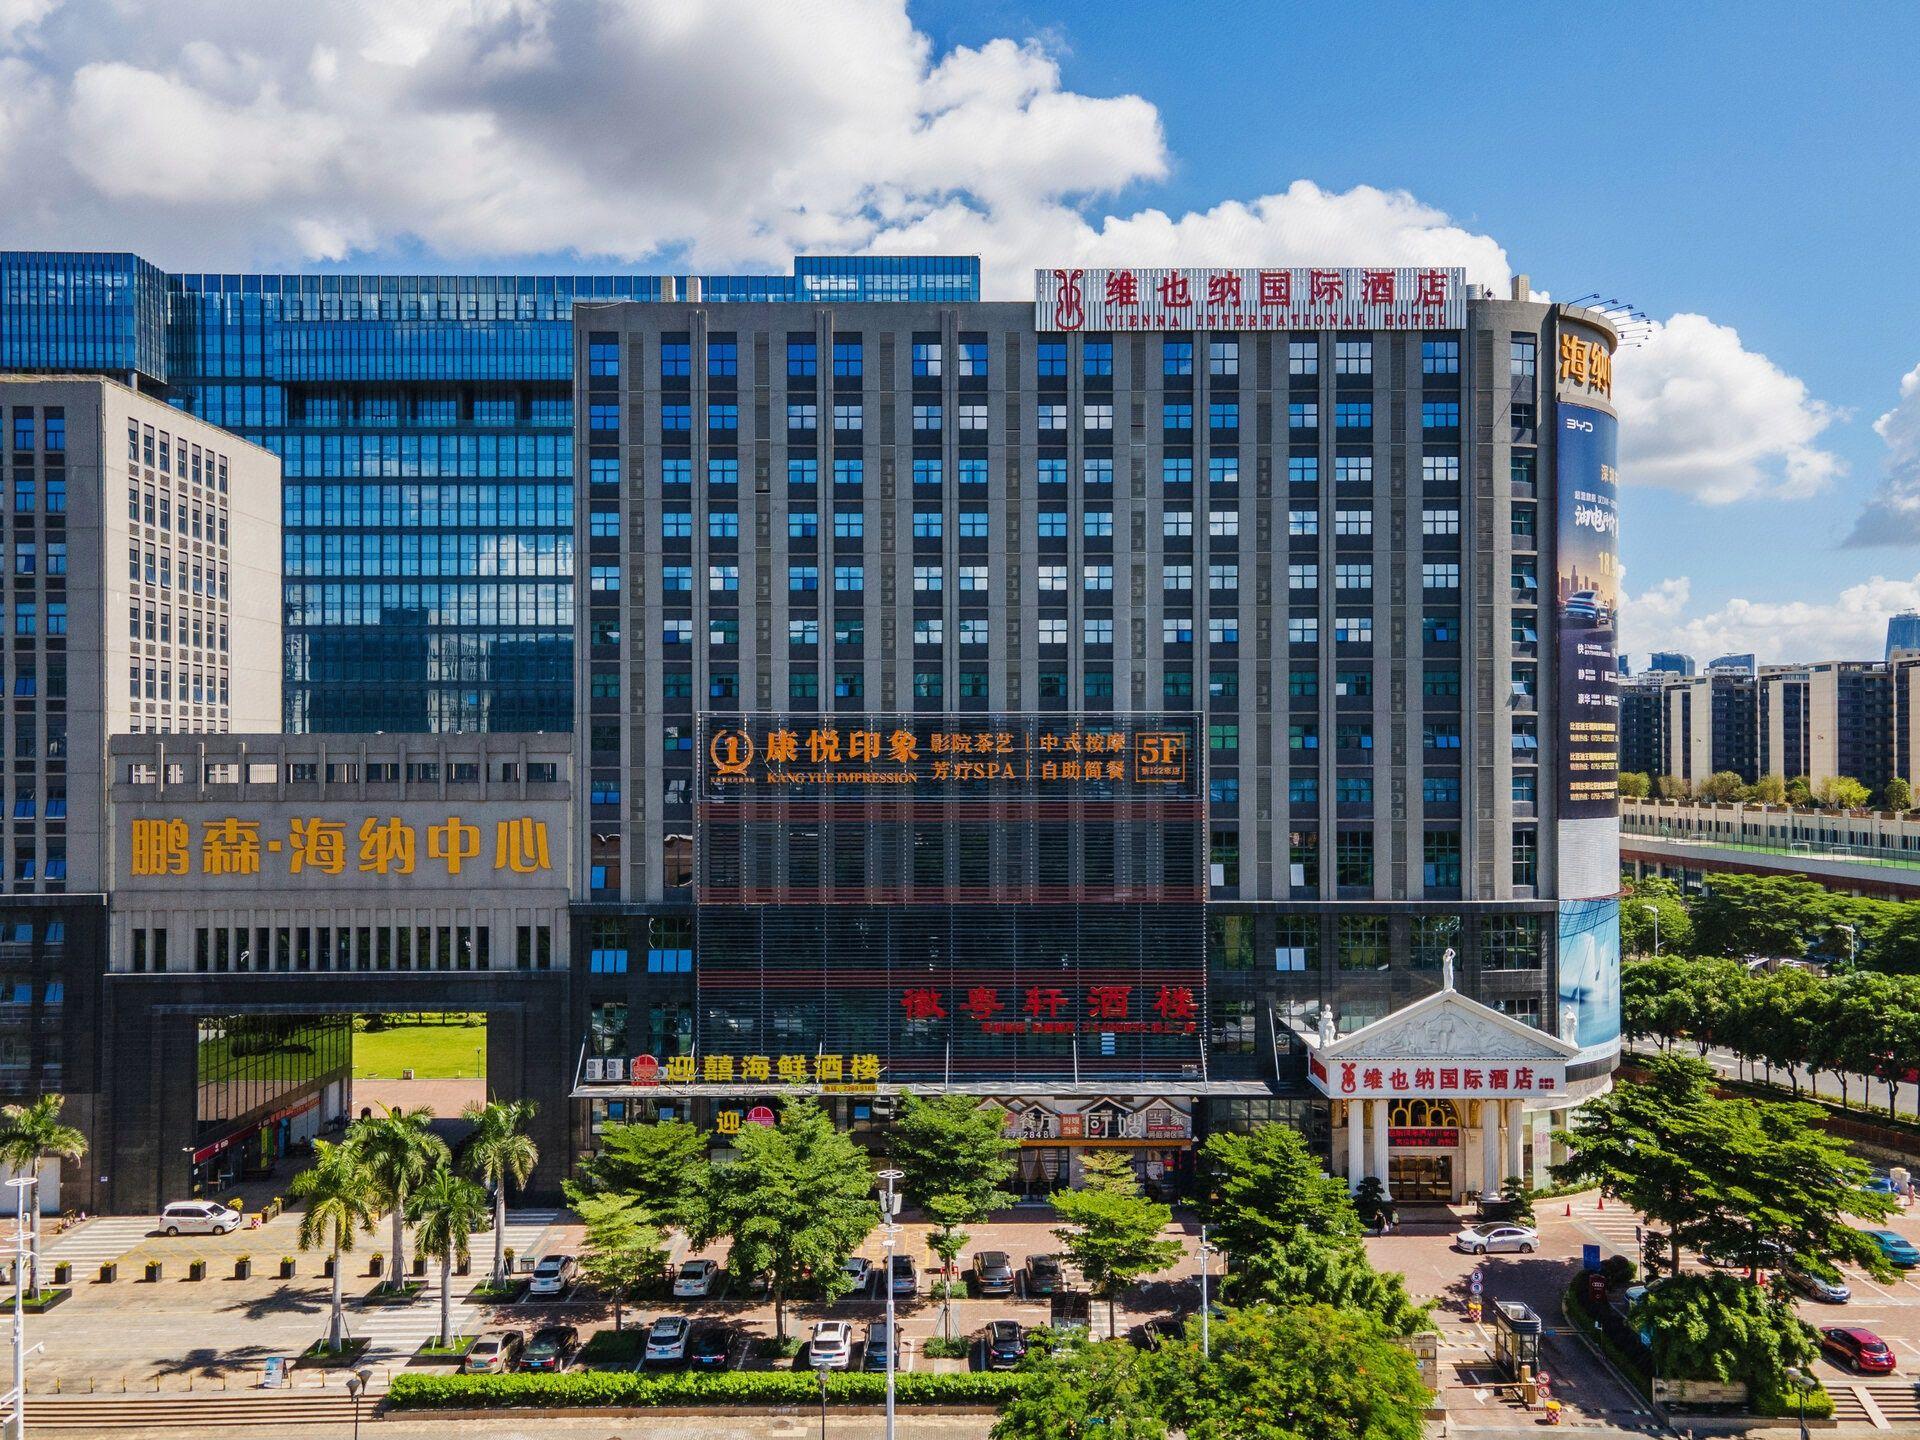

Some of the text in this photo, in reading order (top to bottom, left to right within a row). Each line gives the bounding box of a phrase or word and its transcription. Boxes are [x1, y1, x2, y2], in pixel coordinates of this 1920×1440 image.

[1105, 270, 1447, 308] 维也纳国际酒店
[1105, 312, 1447, 327] VIENNA INTERNATIONAL HOTEL
[1566, 418, 1593, 433] BYD
[766, 729, 920, 763] 康悦印象
[930, 733, 1015, 754] 影院茶艺
[1039, 732, 1126, 753] 中式按摩
[1141, 738, 1181, 763] 5F
[767, 772, 805, 784] KANG
[808, 772, 835, 784] YUE
[837, 772, 918, 784] IMPRESSION
[931, 760, 1016, 781] 芳疗SPA
[1040, 760, 1126, 781] 自助简餐
[131, 817, 552, 875] 鹏森·海纳中心
[1363, 1067, 1535, 1091] 维也纳国际酒店
[716, 1110, 740, 1135] 迎
